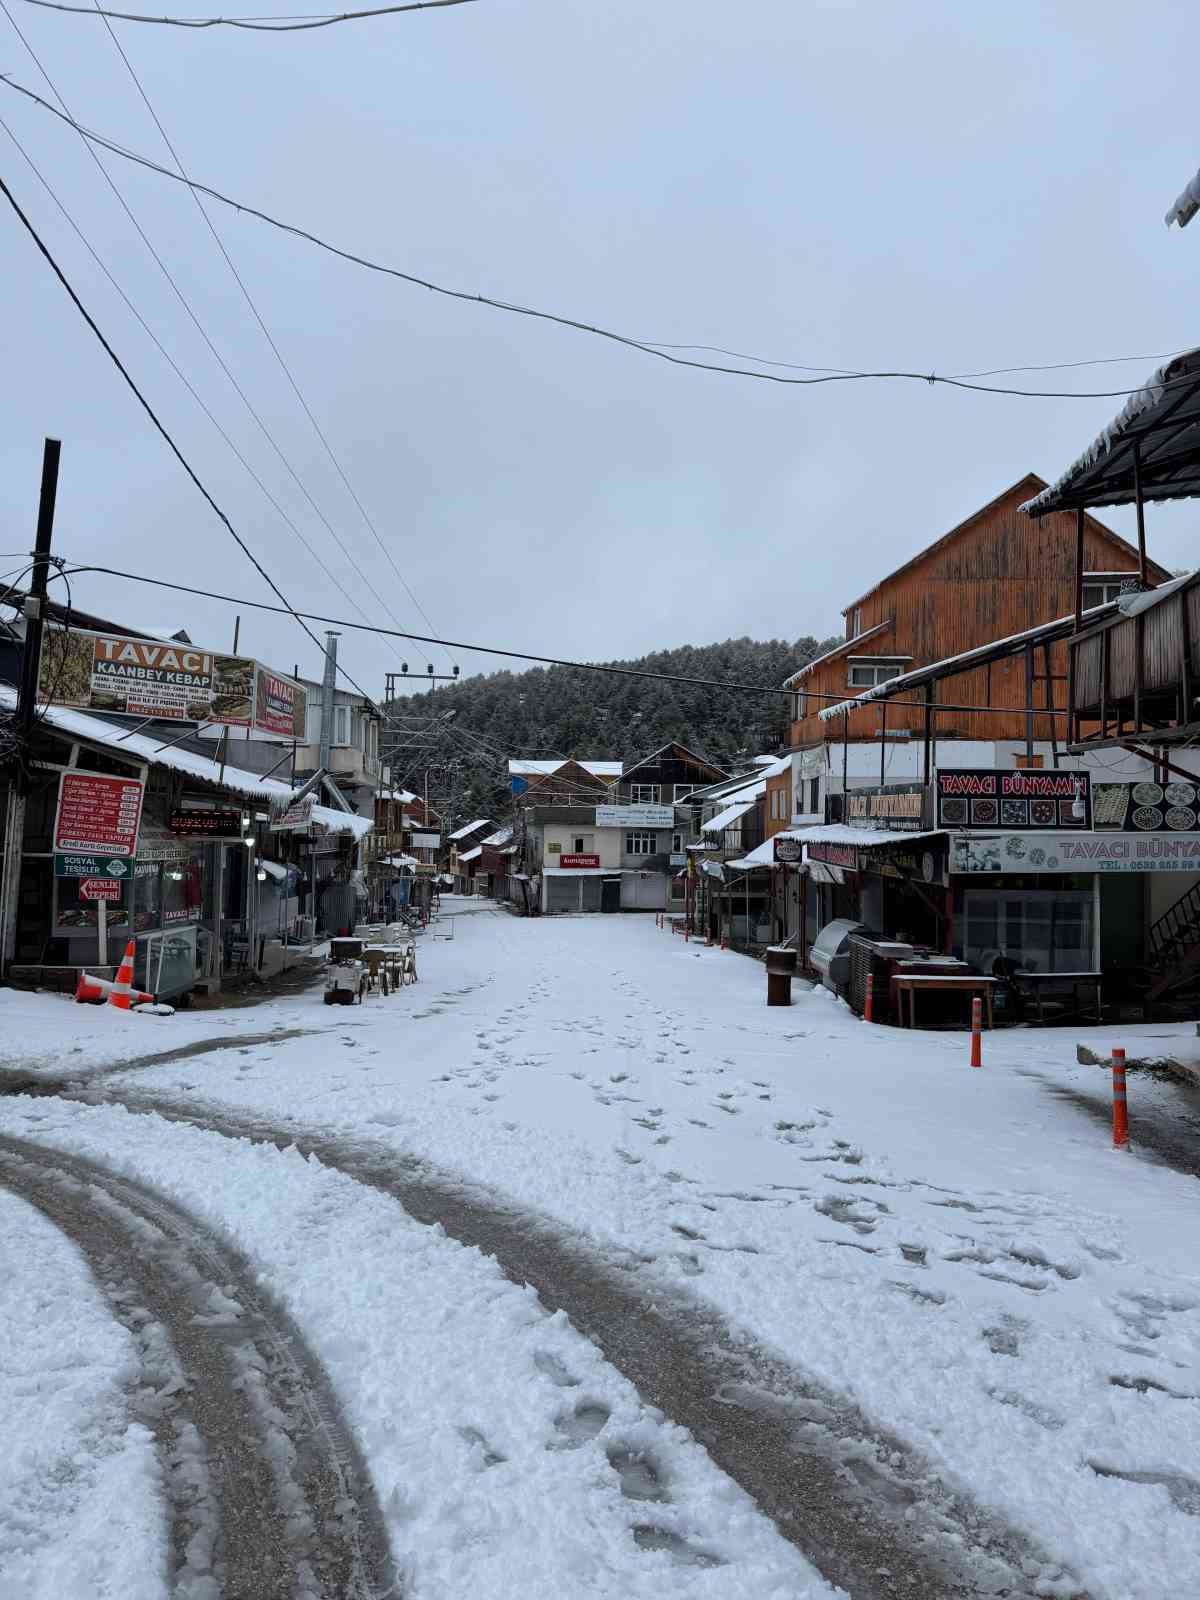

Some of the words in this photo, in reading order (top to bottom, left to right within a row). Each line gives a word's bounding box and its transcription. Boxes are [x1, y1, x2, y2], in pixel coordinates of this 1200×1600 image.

[99, 639, 210, 673] TAVACI
[97, 661, 165, 681] KAANBEY
[166, 672, 210, 687] KEBAP
[270, 679, 294, 704] TAVACI
[940, 775, 996, 794] TAVACI
[1002, 771, 1087, 795] BÜNYAMİN
[64, 856, 97, 865] SOSYAL
[1059, 841, 1130, 859] TAVACI
[64, 864, 101, 873] TESİSLER
